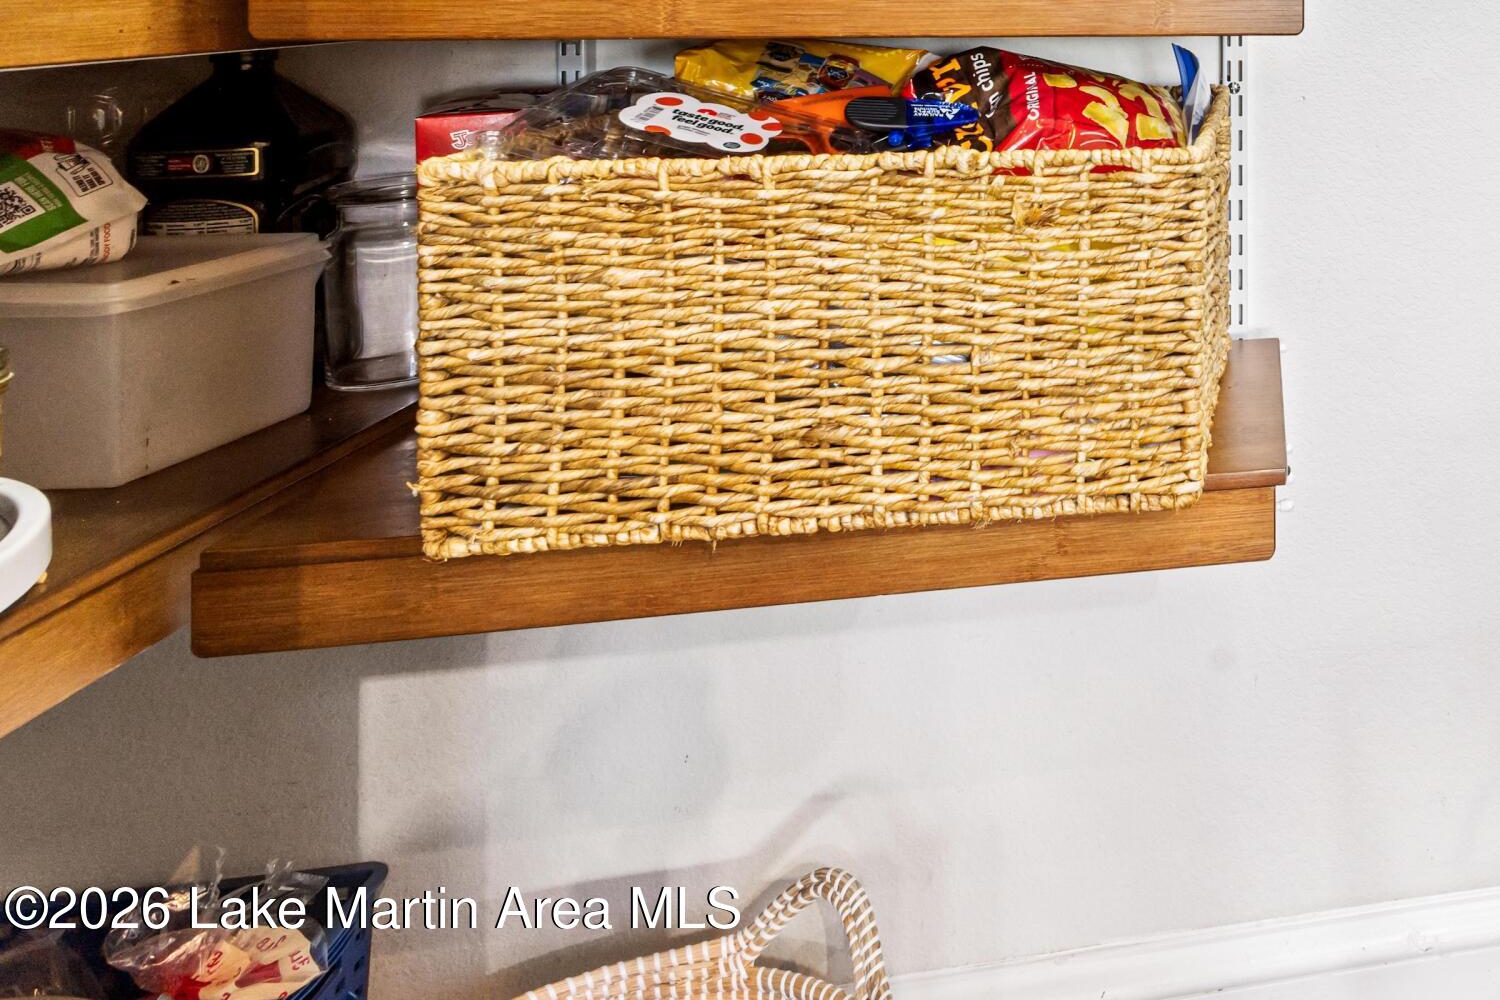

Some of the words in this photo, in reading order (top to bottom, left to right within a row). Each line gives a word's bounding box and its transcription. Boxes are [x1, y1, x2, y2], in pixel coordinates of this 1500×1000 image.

[970, 52, 994, 92] chips
[1023, 71, 1041, 122] ORIGINAL
[671, 108, 708, 121] taste
[671, 114, 699, 127] feel
[699, 121, 735, 135] good.
